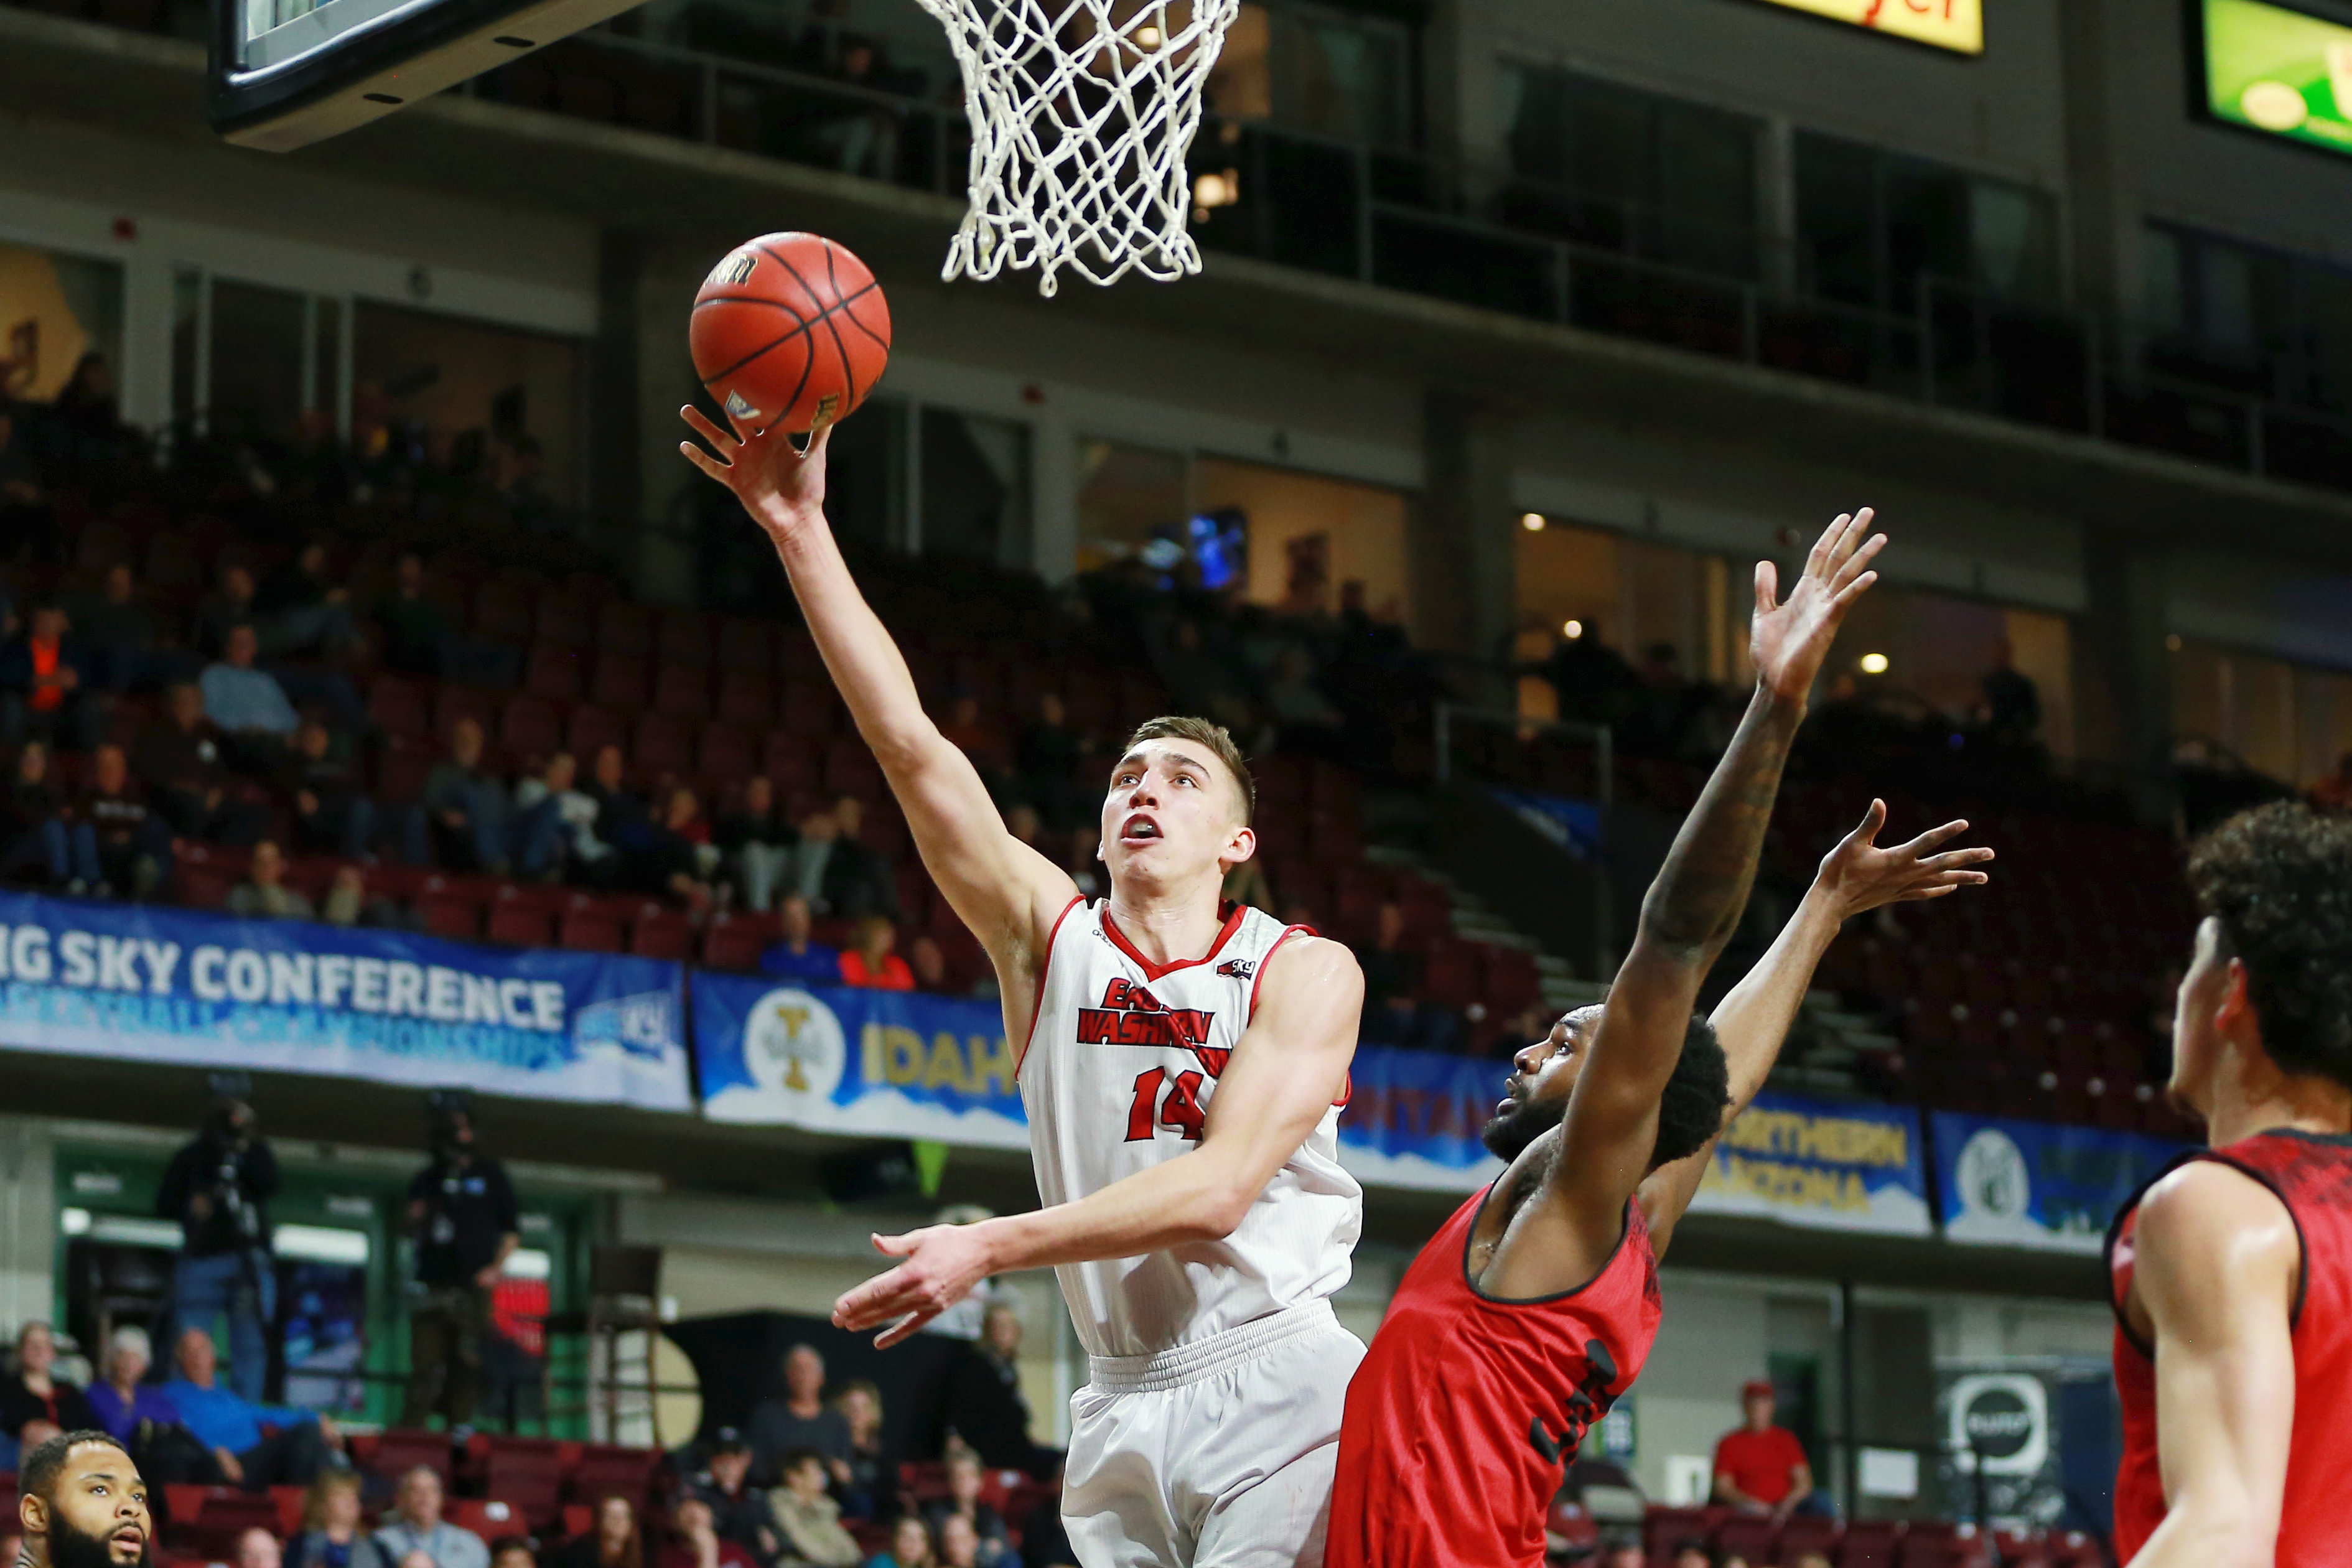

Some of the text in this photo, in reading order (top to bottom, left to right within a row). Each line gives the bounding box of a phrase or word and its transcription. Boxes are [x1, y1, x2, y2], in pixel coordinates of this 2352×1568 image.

[59, 928, 182, 996] SKY
[190, 942, 565, 1032] CONFERENCE
[1232, 959, 1255, 974] SKY
[1123, 1065, 1205, 1143] 14
